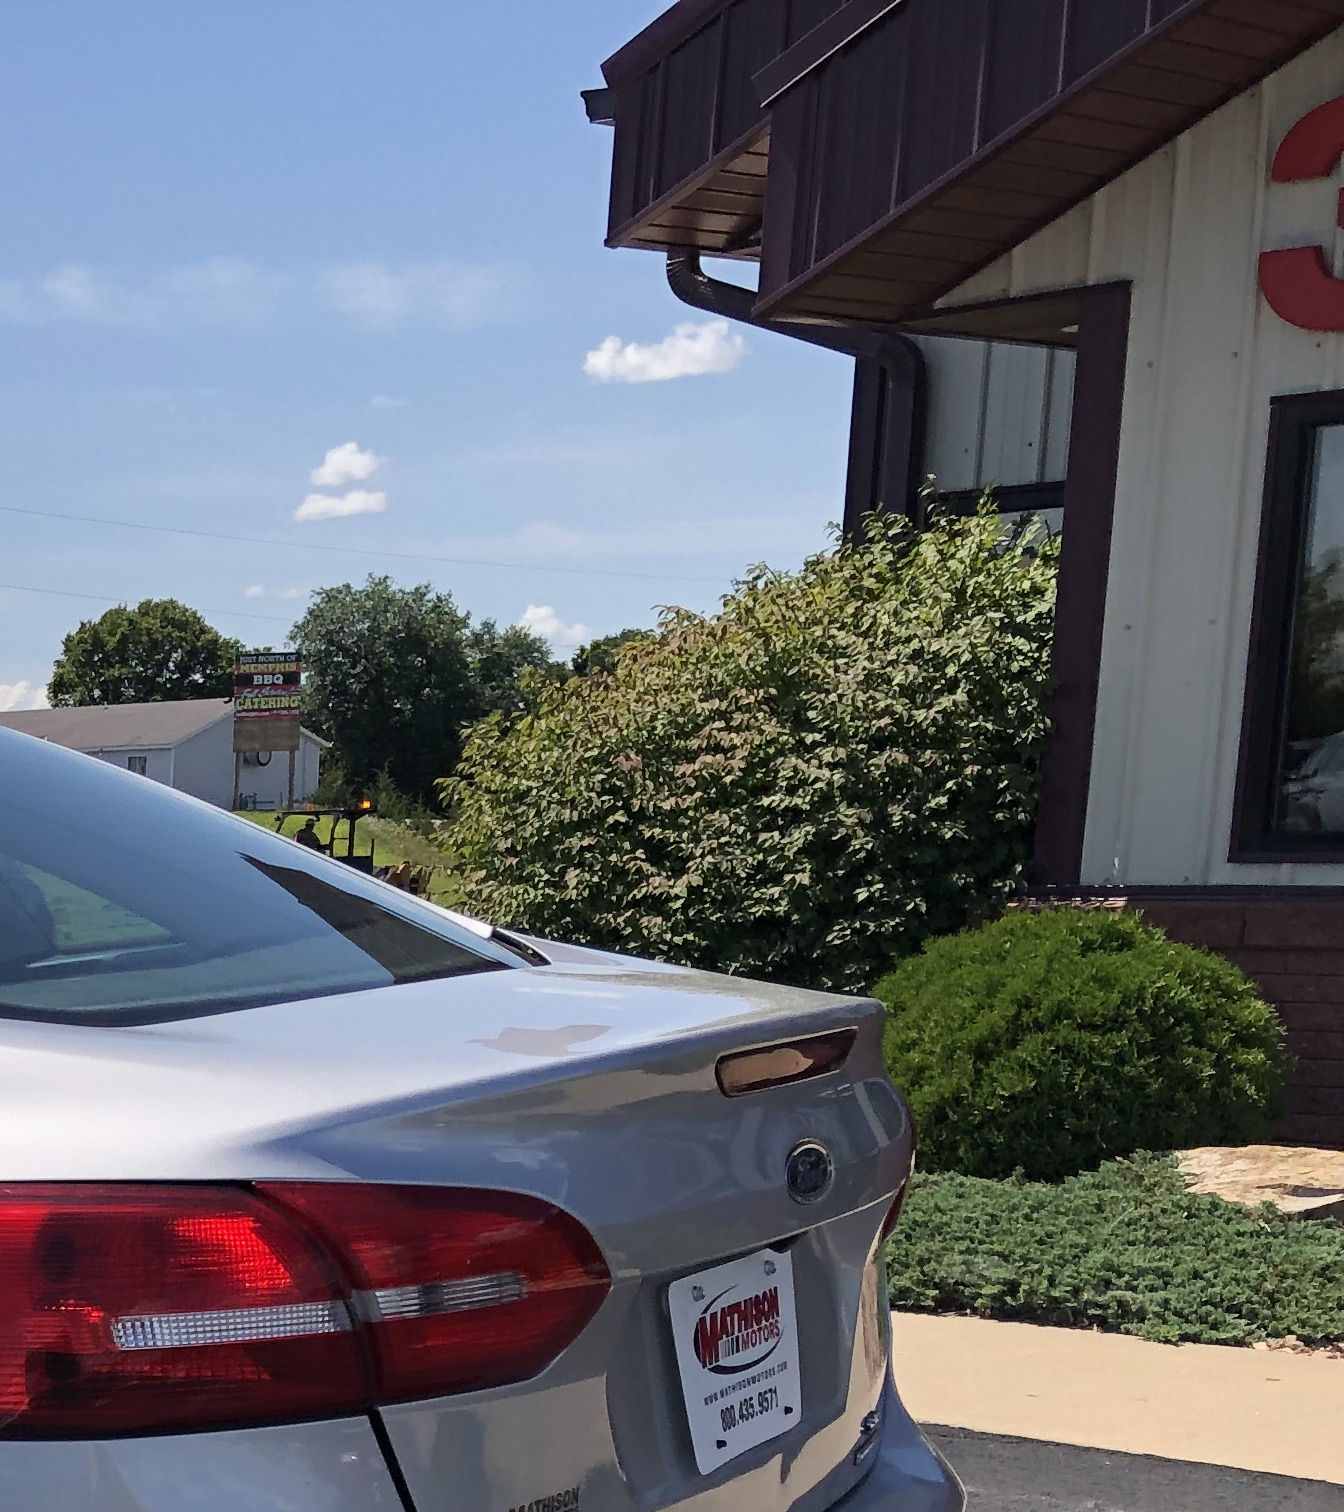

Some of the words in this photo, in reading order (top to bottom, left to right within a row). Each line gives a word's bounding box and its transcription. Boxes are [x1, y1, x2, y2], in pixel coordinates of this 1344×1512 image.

[240, 663, 297, 672] MEMPHIS
[253, 674, 283, 684] BBQ
[236, 697, 300, 710] CATERING
[698, 1286, 780, 1369] MATHISON
[741, 1319, 781, 1351] MOTORS
[720, 1385, 779, 1432] 800.435.9571
